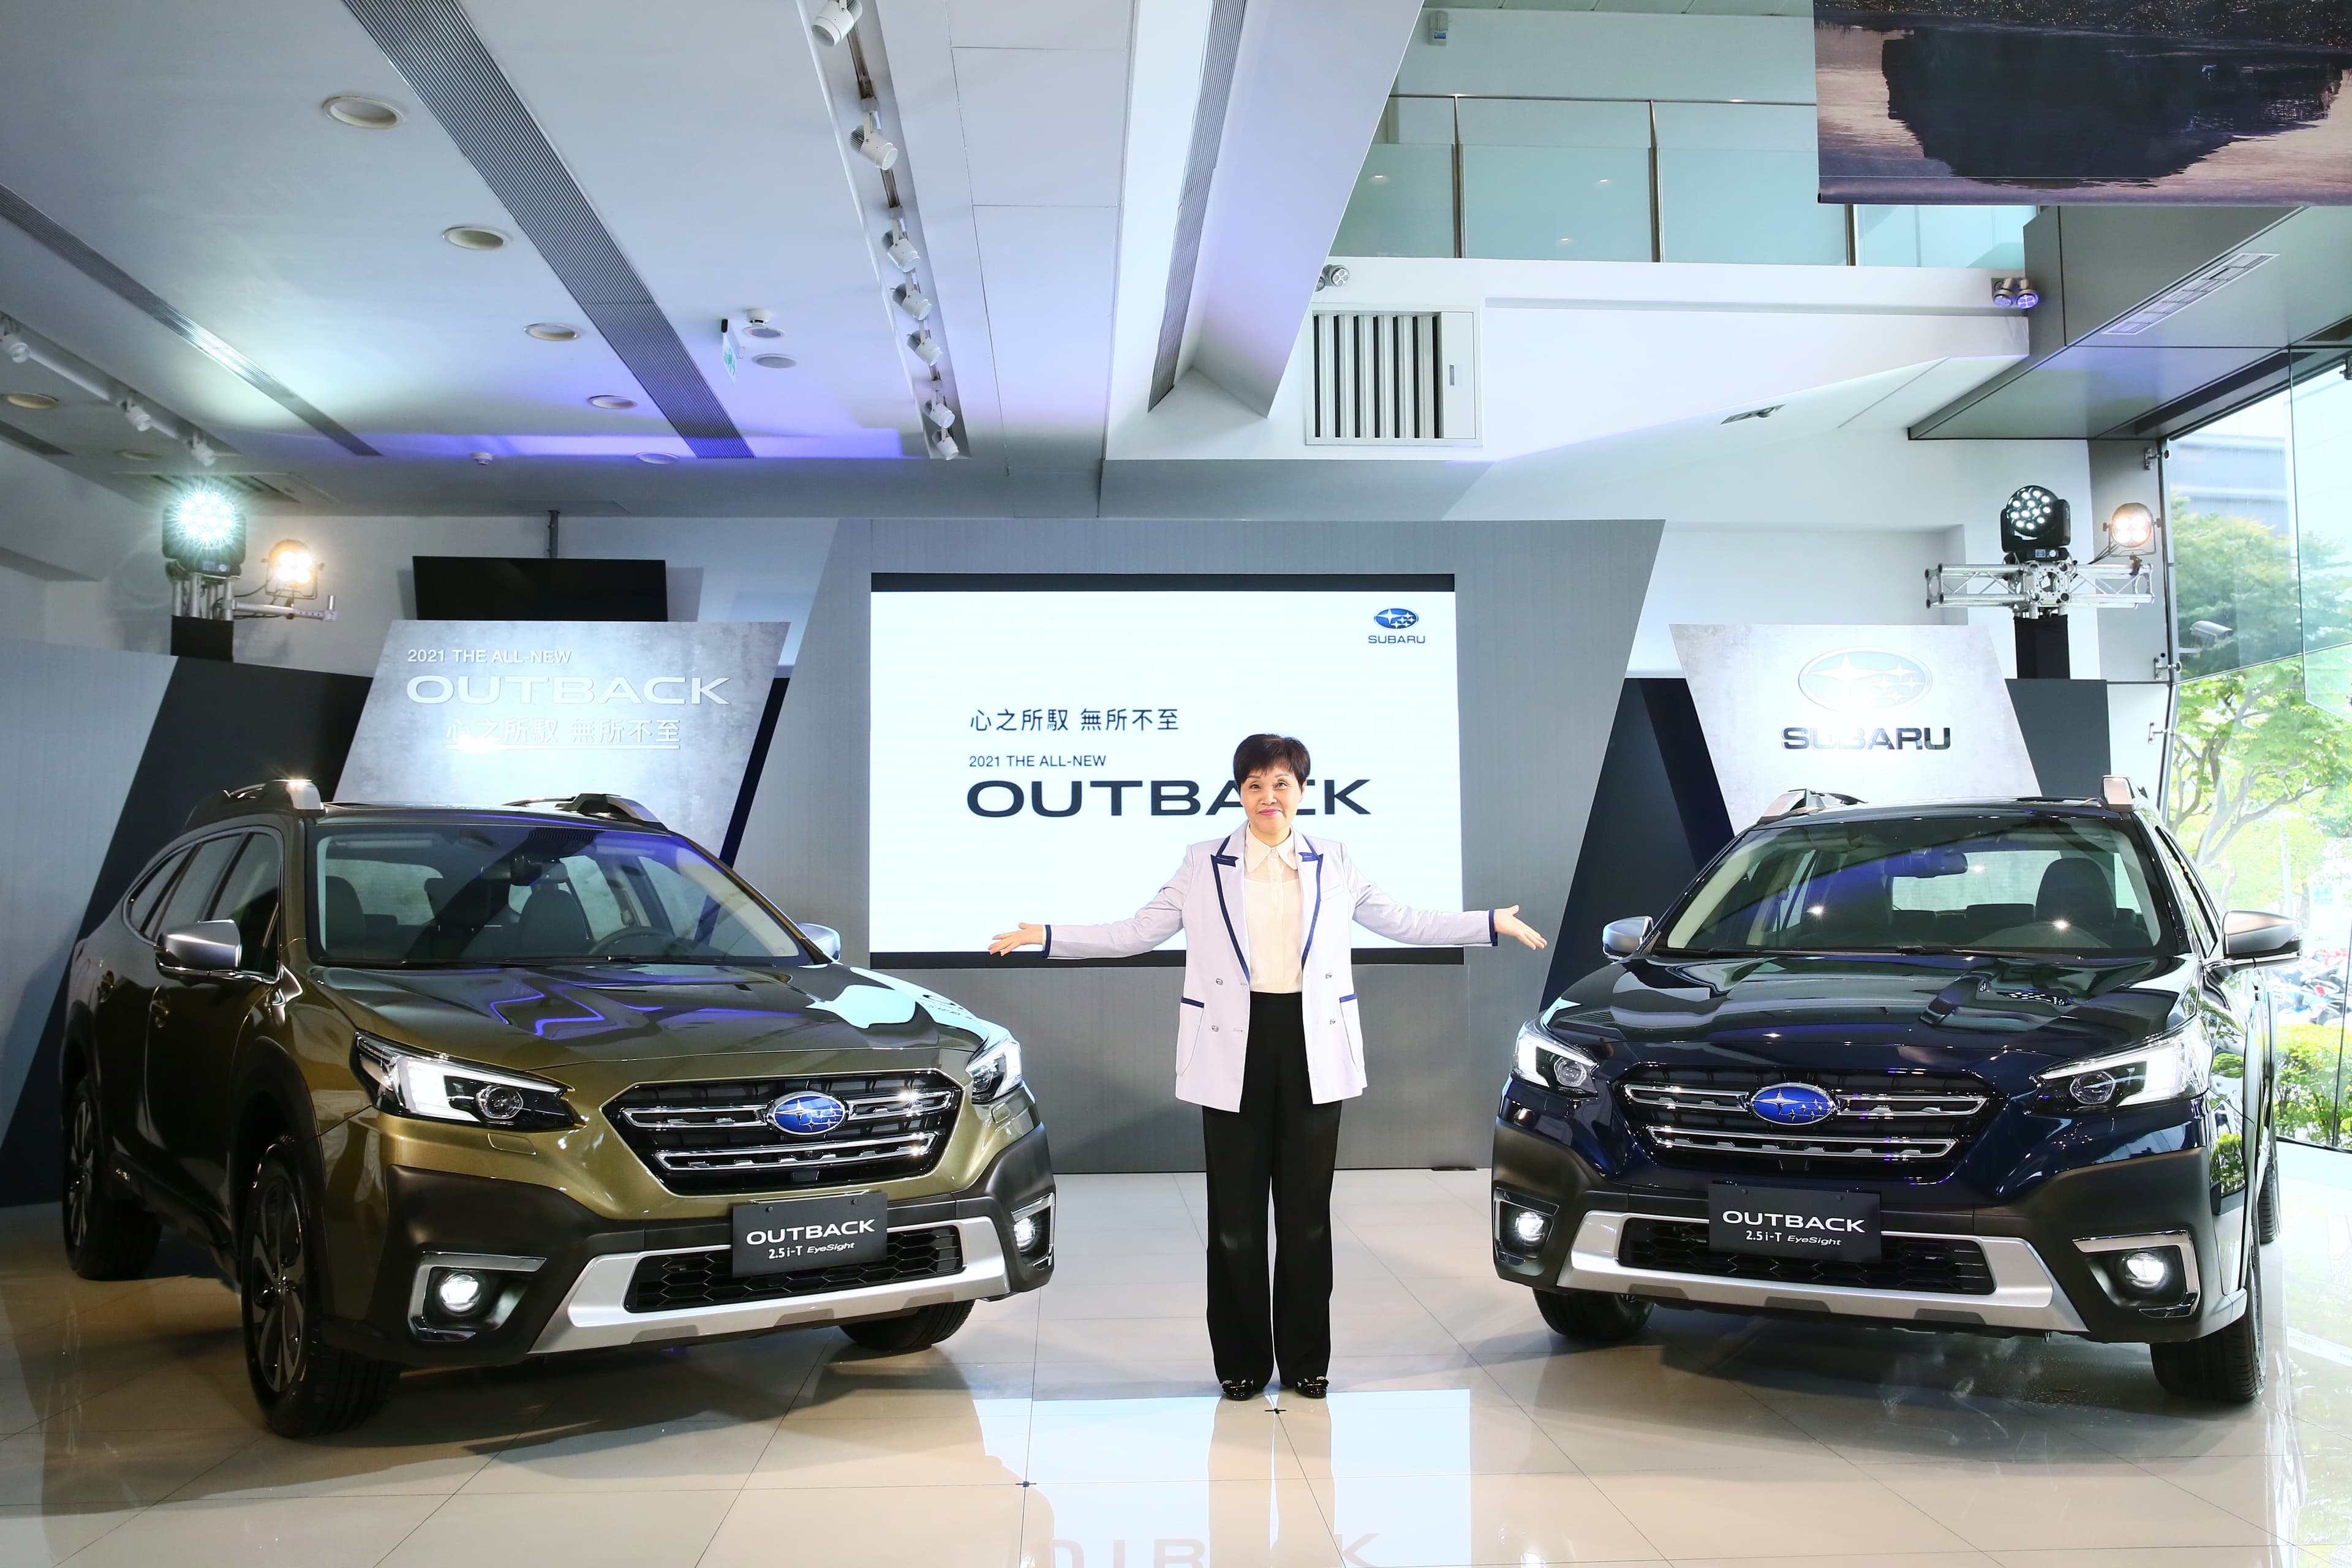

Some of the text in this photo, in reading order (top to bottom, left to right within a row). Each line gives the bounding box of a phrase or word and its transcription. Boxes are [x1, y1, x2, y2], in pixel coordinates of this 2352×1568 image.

[1368, 635, 1425, 644] SUBARU
[407, 649, 573, 663] 2021 THE ALL-NEW
[406, 675, 731, 704] OUTBACK
[569, 718, 681, 743] 無所不至
[970, 707, 1179, 731] 心之所馭 無所不至
[1781, 726, 1951, 750] SUBARU
[969, 754, 1107, 767] 2021 THE ALL-NEW
[746, 1219, 876, 1245] OUTBACK
[1722, 1210, 1866, 1233] OUTBACK
[807, 1242, 856, 1254] EyeSight
[1787, 1235, 1842, 1246] EyeSight
